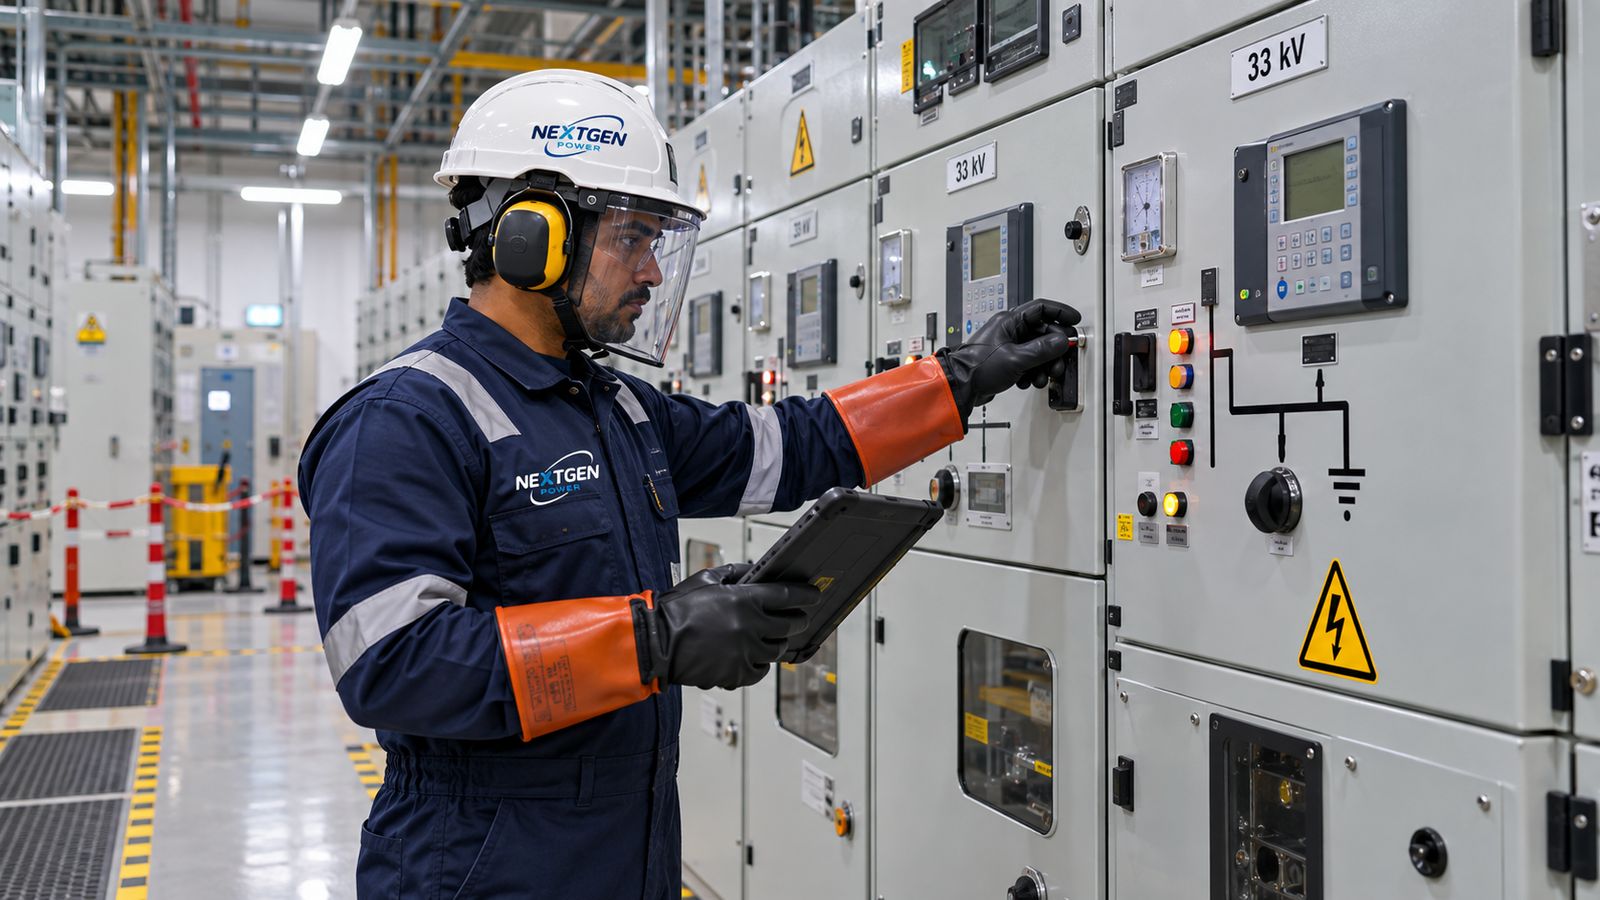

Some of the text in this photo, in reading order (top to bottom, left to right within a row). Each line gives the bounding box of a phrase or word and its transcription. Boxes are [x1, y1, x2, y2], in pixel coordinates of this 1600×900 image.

[1248, 33, 1306, 82] 33 kV
[531, 125, 628, 147] NEXTGEN
[557, 141, 601, 152] POWER
[956, 152, 986, 183] 33 kV
[515, 464, 600, 491] NEXTGEN
[540, 483, 581, 496] POWER
